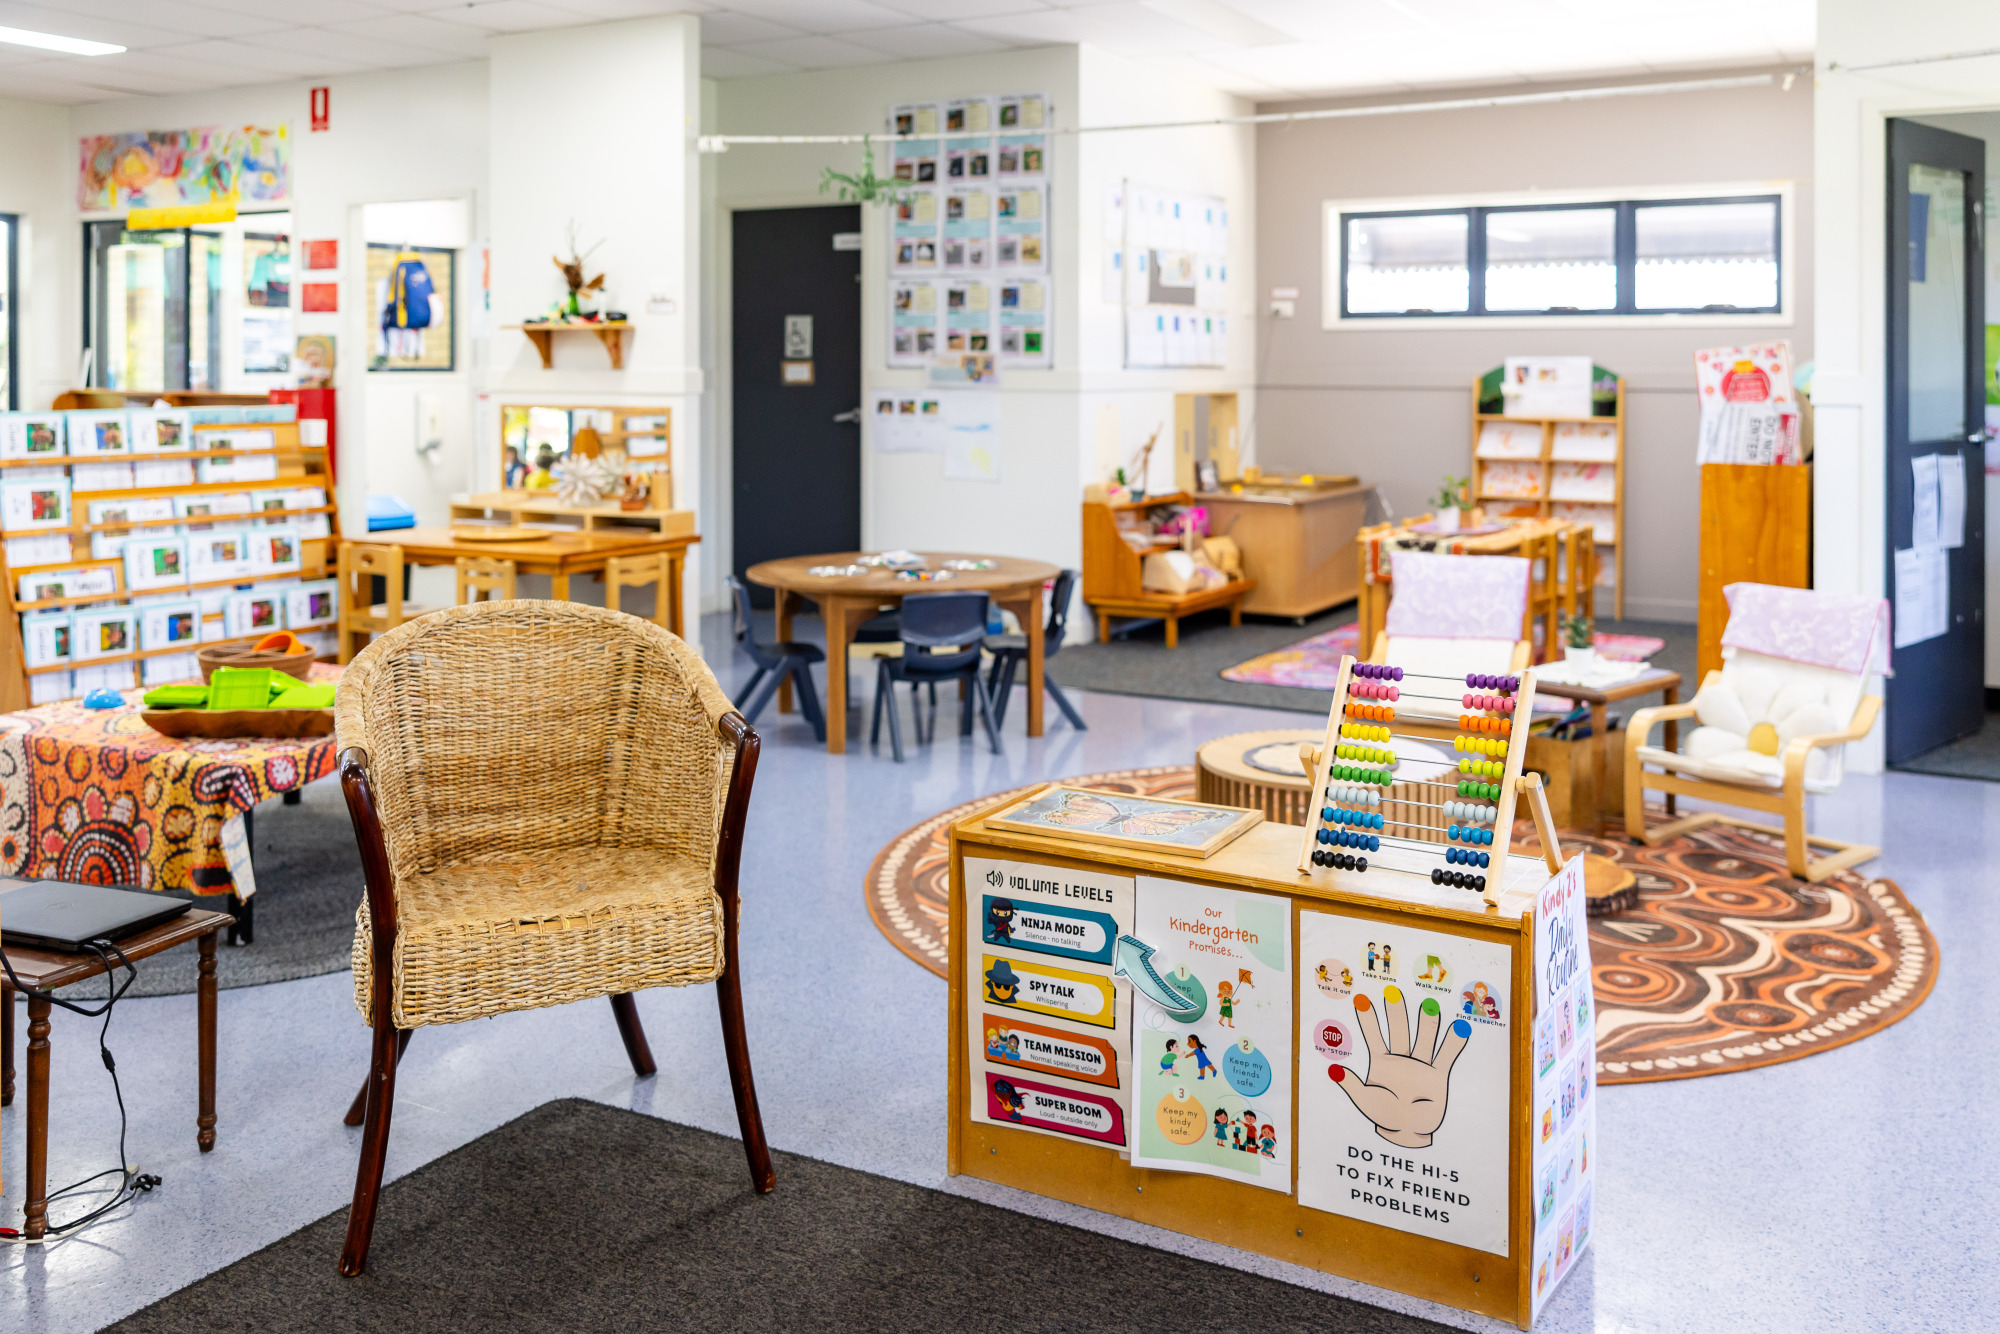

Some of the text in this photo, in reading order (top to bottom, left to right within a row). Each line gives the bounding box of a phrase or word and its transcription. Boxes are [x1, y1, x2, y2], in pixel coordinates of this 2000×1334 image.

[1010, 875, 1112, 902] VOLUME LEVELS
[1542, 878, 1564, 919] Kindy
[1204, 908, 1222, 918] Our
[1021, 917, 1085, 936] NINJA MODE
[1170, 917, 1258, 944] Kindergarten
[1549, 906, 1573, 955] Daily
[1025, 932, 1046, 941] Silence
[1061, 937, 1081, 947] talking
[1180, 968, 1184, 976] 1
[1546, 944, 1578, 1004] Routine
[1030, 981, 1074, 998] SPY TALK
[1317, 984, 1331, 992] Talk
[1434, 985, 1451, 993] away
[1036, 996, 1068, 1008] Whispering
[1479, 1018, 1506, 1027] teacher
[1323, 1031, 1342, 1043] STOP
[1024, 1039, 1101, 1064] TEAM MISSION
[1243, 1040, 1248, 1050] 2
[1315, 1045, 1326, 1053] Say
[1030, 1054, 1097, 1073] Normal speaking voice
[1230, 1057, 1262, 1070] Keep my
[1233, 1068, 1260, 1079] friends
[1237, 1078, 1255, 1088] safe.
[1178, 1088, 1184, 1098] 3
[1035, 1097, 1101, 1118] SUPER BOOM
[1164, 1107, 1198, 1118] Keep my
[1040, 1111, 1055, 1119] Loud
[1060, 1115, 1083, 1124] outside
[1084, 1119, 1097, 1128] only
[1170, 1116, 1191, 1128] kindy
[1170, 1128, 1190, 1136] safe.
[1348, 1146, 1459, 1182] DO THE HI-5
[1337, 1164, 1470, 1206] TO FIX FRIEND
[1351, 1188, 1449, 1223] PROBLEMS
